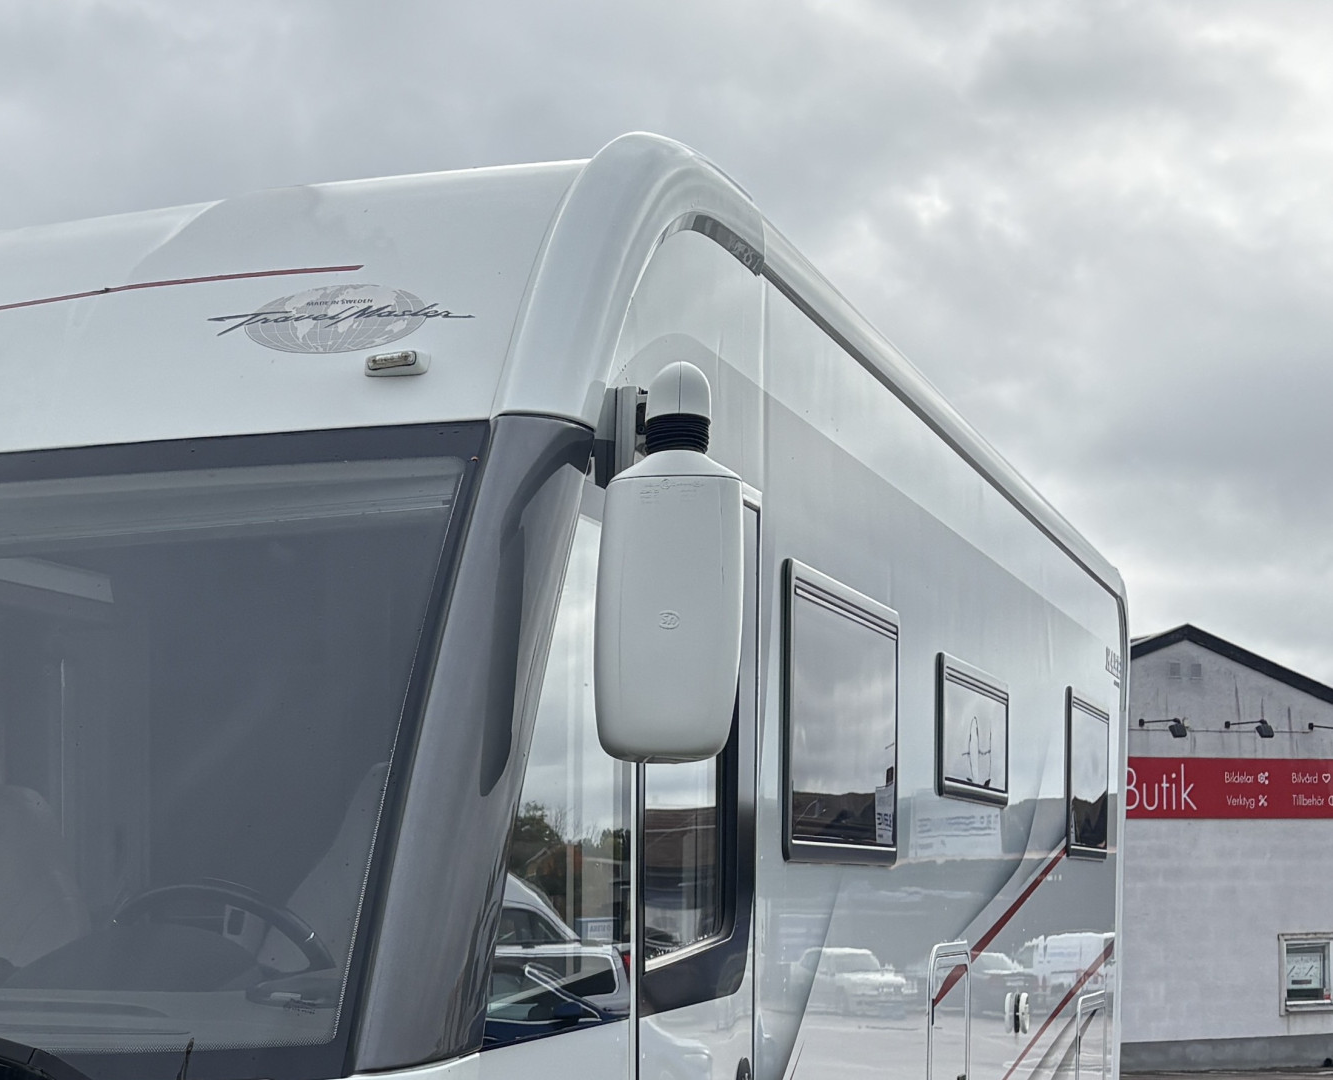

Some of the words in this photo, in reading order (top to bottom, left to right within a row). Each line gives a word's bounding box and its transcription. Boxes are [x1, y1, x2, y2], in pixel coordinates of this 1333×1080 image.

[1224, 771, 1254, 784] Bildelar
[1291, 771, 1318, 784] Bilvård
[1126, 763, 1198, 811] Butik
[1226, 794, 1256, 809] Verktyg
[1292, 794, 1325, 806] Tillbehör
